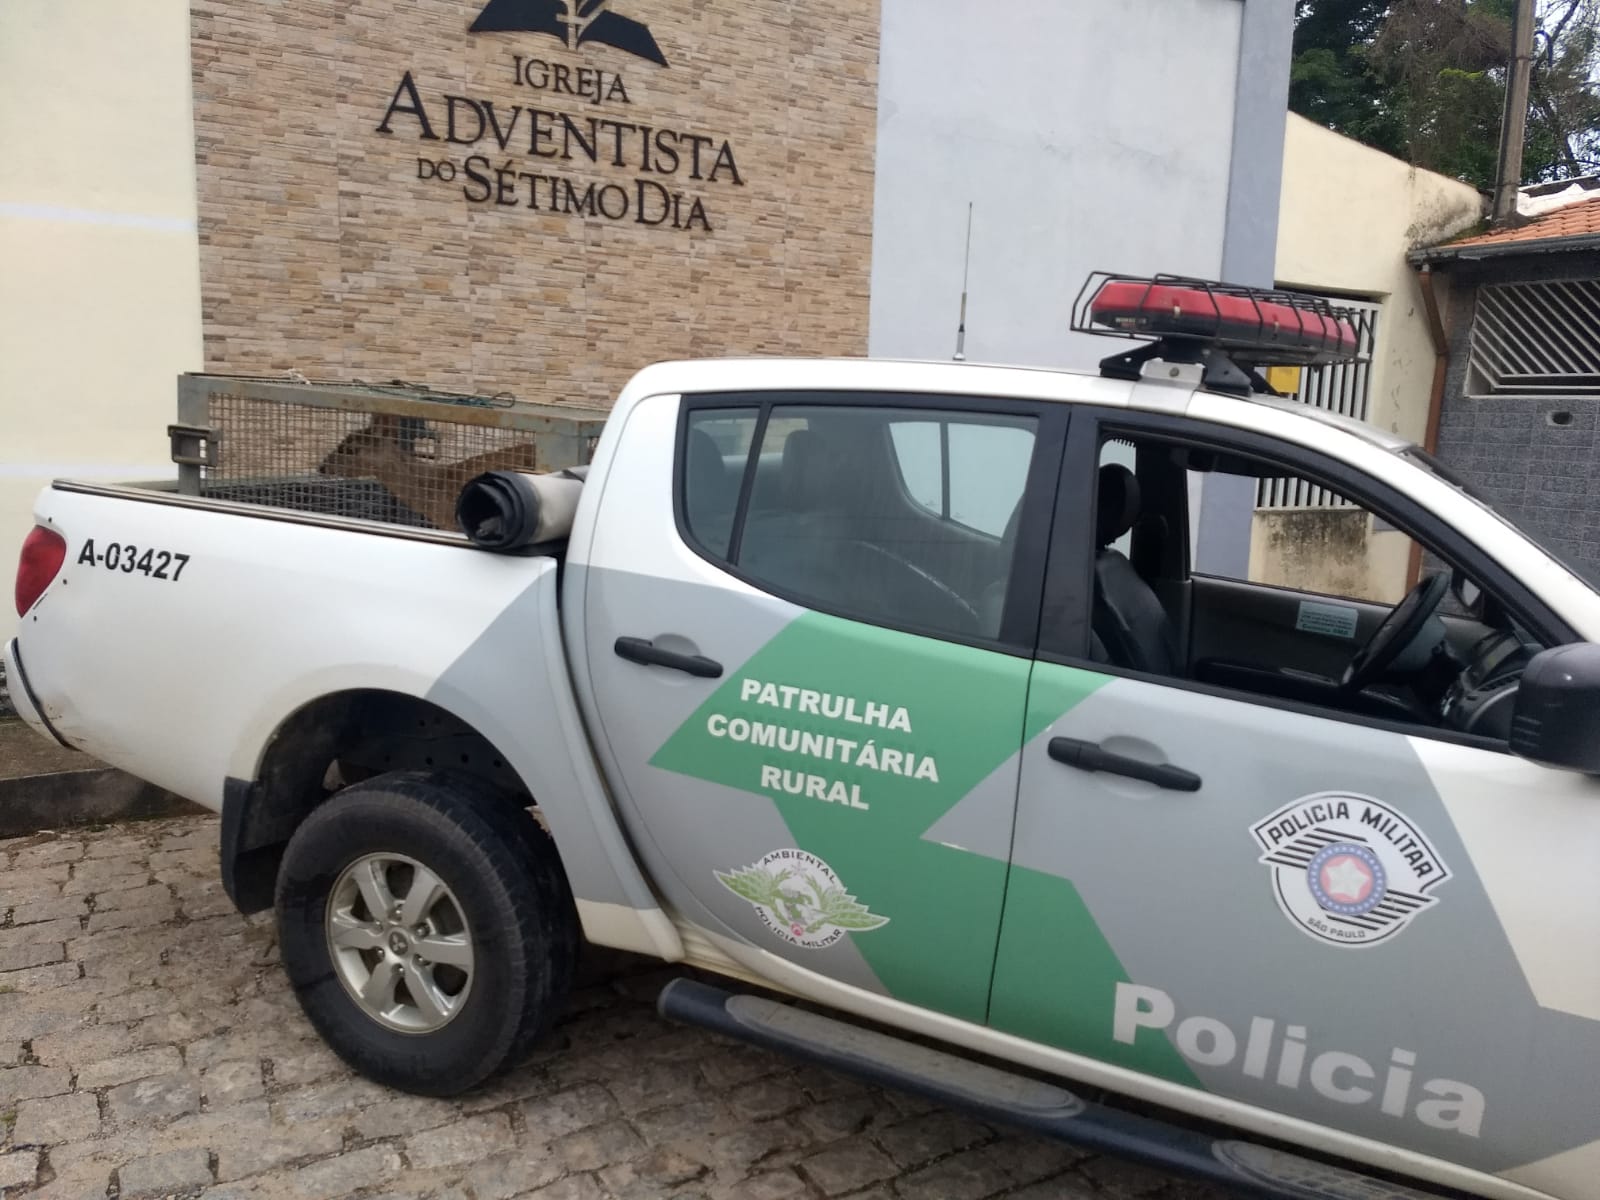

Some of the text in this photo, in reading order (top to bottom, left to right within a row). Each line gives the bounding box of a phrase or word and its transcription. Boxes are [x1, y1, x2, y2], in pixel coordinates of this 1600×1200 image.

[513, 55, 631, 105] IGREJA
[375, 70, 745, 186] ADVENTISTA
[416, 157, 457, 182] DO
[77, 538, 190, 582] A-03427
[740, 678, 912, 733] PATRULHA
[707, 714, 939, 783] COMUNITÁRIA
[760, 764, 869, 810] RURAL
[1267, 802, 1434, 878] POLICIA MILITAR
[763, 850, 836, 884] AMBIENTAL
[801, 928, 842, 948] MILITAR
[1329, 928, 1366, 938] PAULO
[1112, 981, 1486, 1139] Policia
